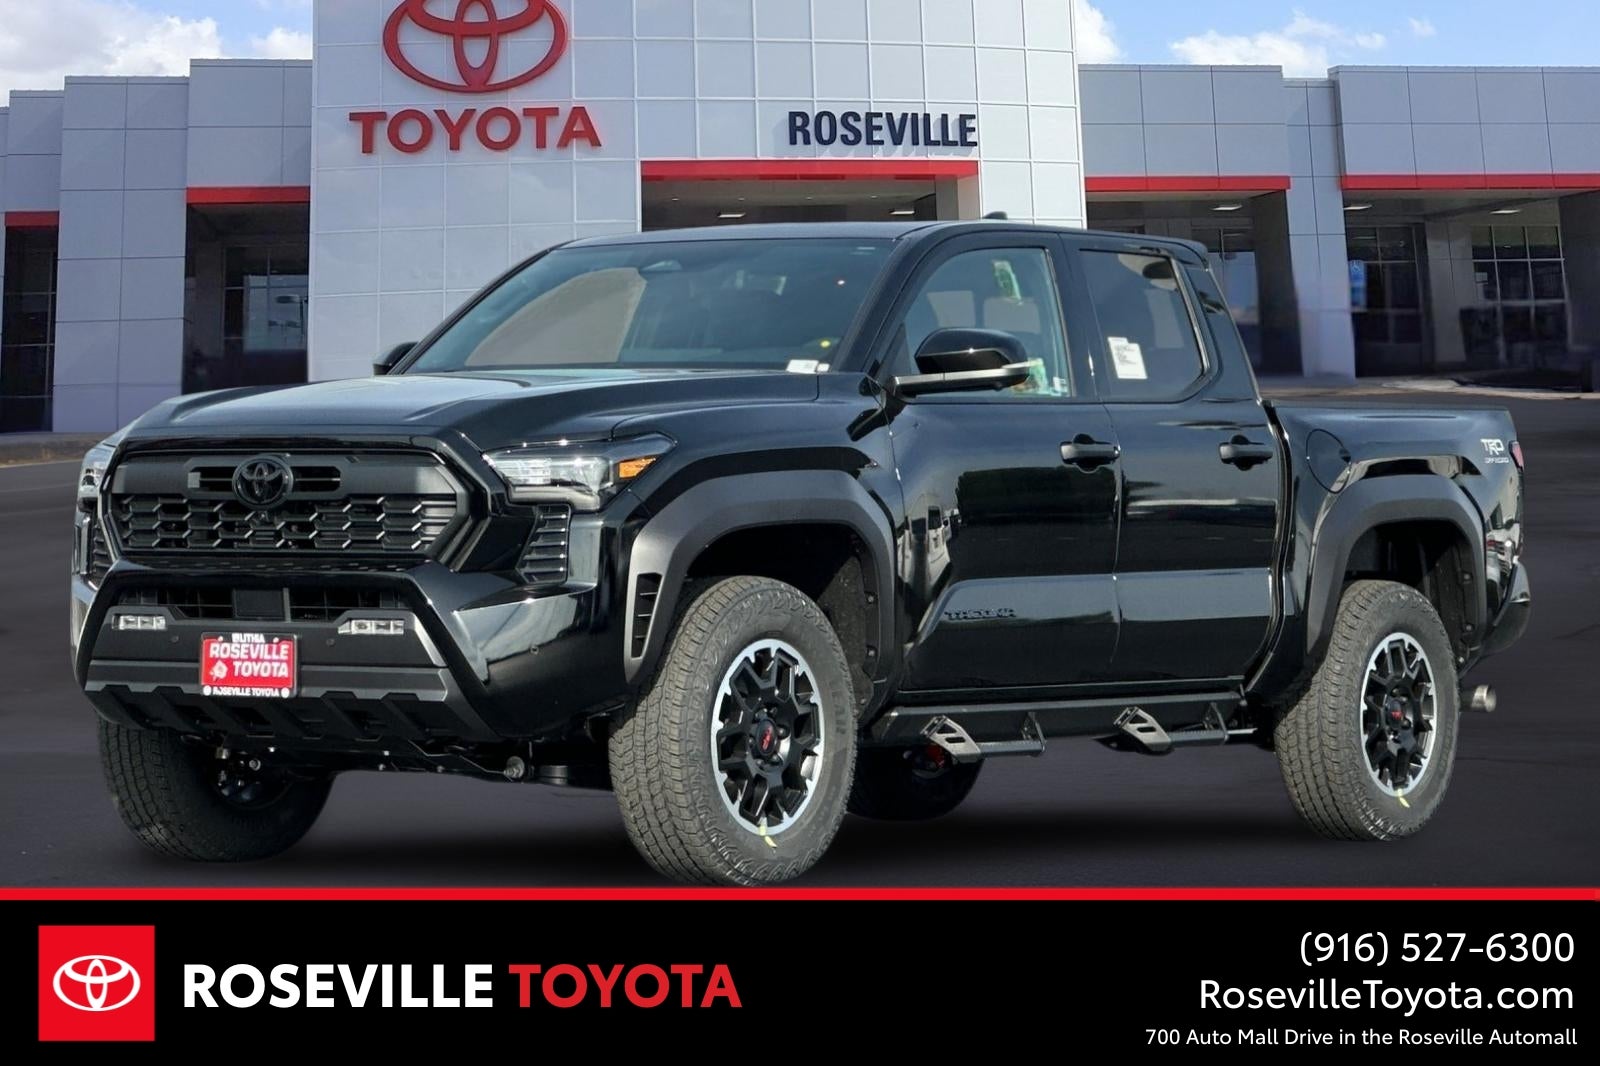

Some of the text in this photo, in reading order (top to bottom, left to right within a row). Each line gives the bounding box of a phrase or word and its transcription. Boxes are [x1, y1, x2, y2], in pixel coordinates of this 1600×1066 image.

[349, 106, 602, 153] TOYOTA
[788, 111, 978, 147] ROSEVILLE
[209, 642, 290, 660] ROSEVILLE
[233, 660, 289, 678] TOYOTA
[212, 686, 280, 697] ROSEVILLE TOYOTA
